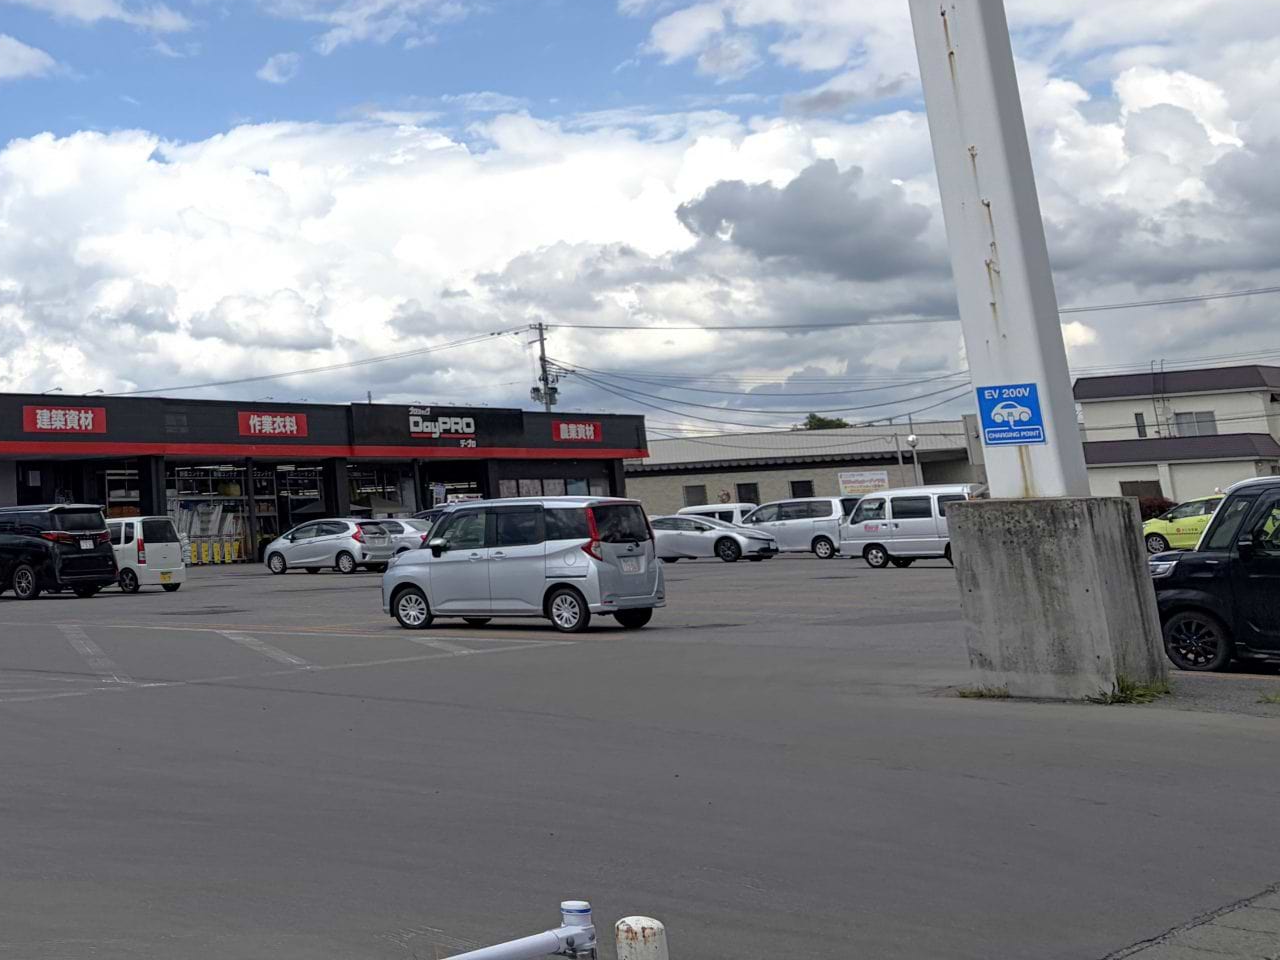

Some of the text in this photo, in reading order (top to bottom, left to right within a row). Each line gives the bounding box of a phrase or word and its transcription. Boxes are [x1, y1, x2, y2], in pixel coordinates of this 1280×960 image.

[984, 387, 1030, 399] EV 200V
[35, 409, 93, 430] 建築資材
[249, 414, 298, 434] 作業衣料
[409, 416, 475, 438] DayPRO
[988, 431, 1020, 439] CHARGING
